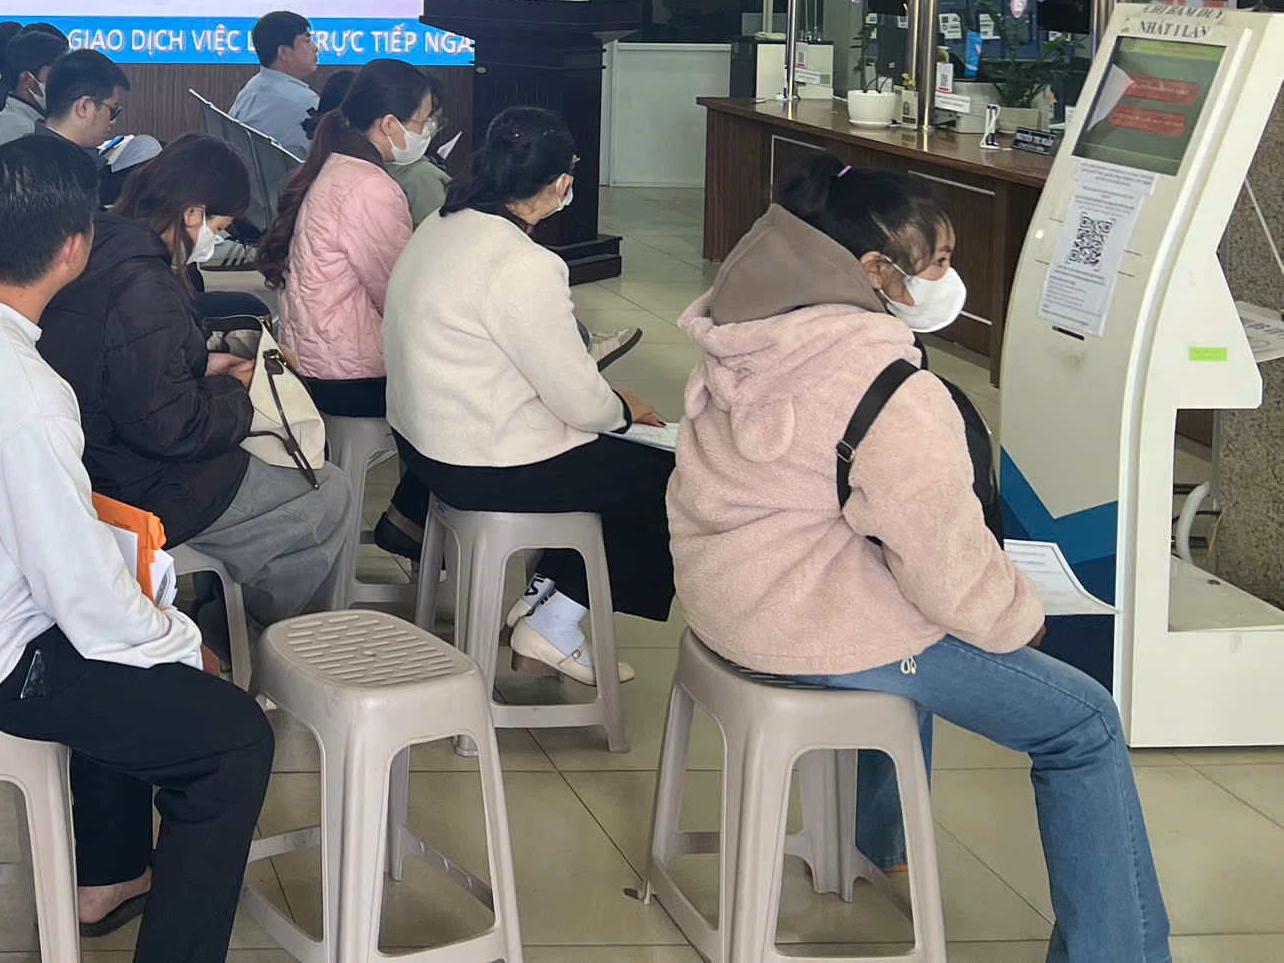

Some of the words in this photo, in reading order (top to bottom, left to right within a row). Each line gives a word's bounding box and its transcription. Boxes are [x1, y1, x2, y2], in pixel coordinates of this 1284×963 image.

[69, 28, 123, 51] GIAO
[131, 28, 188, 56] DỊCH
[192, 24, 242, 56] VIỆC
[371, 22, 417, 54] TIẾP
